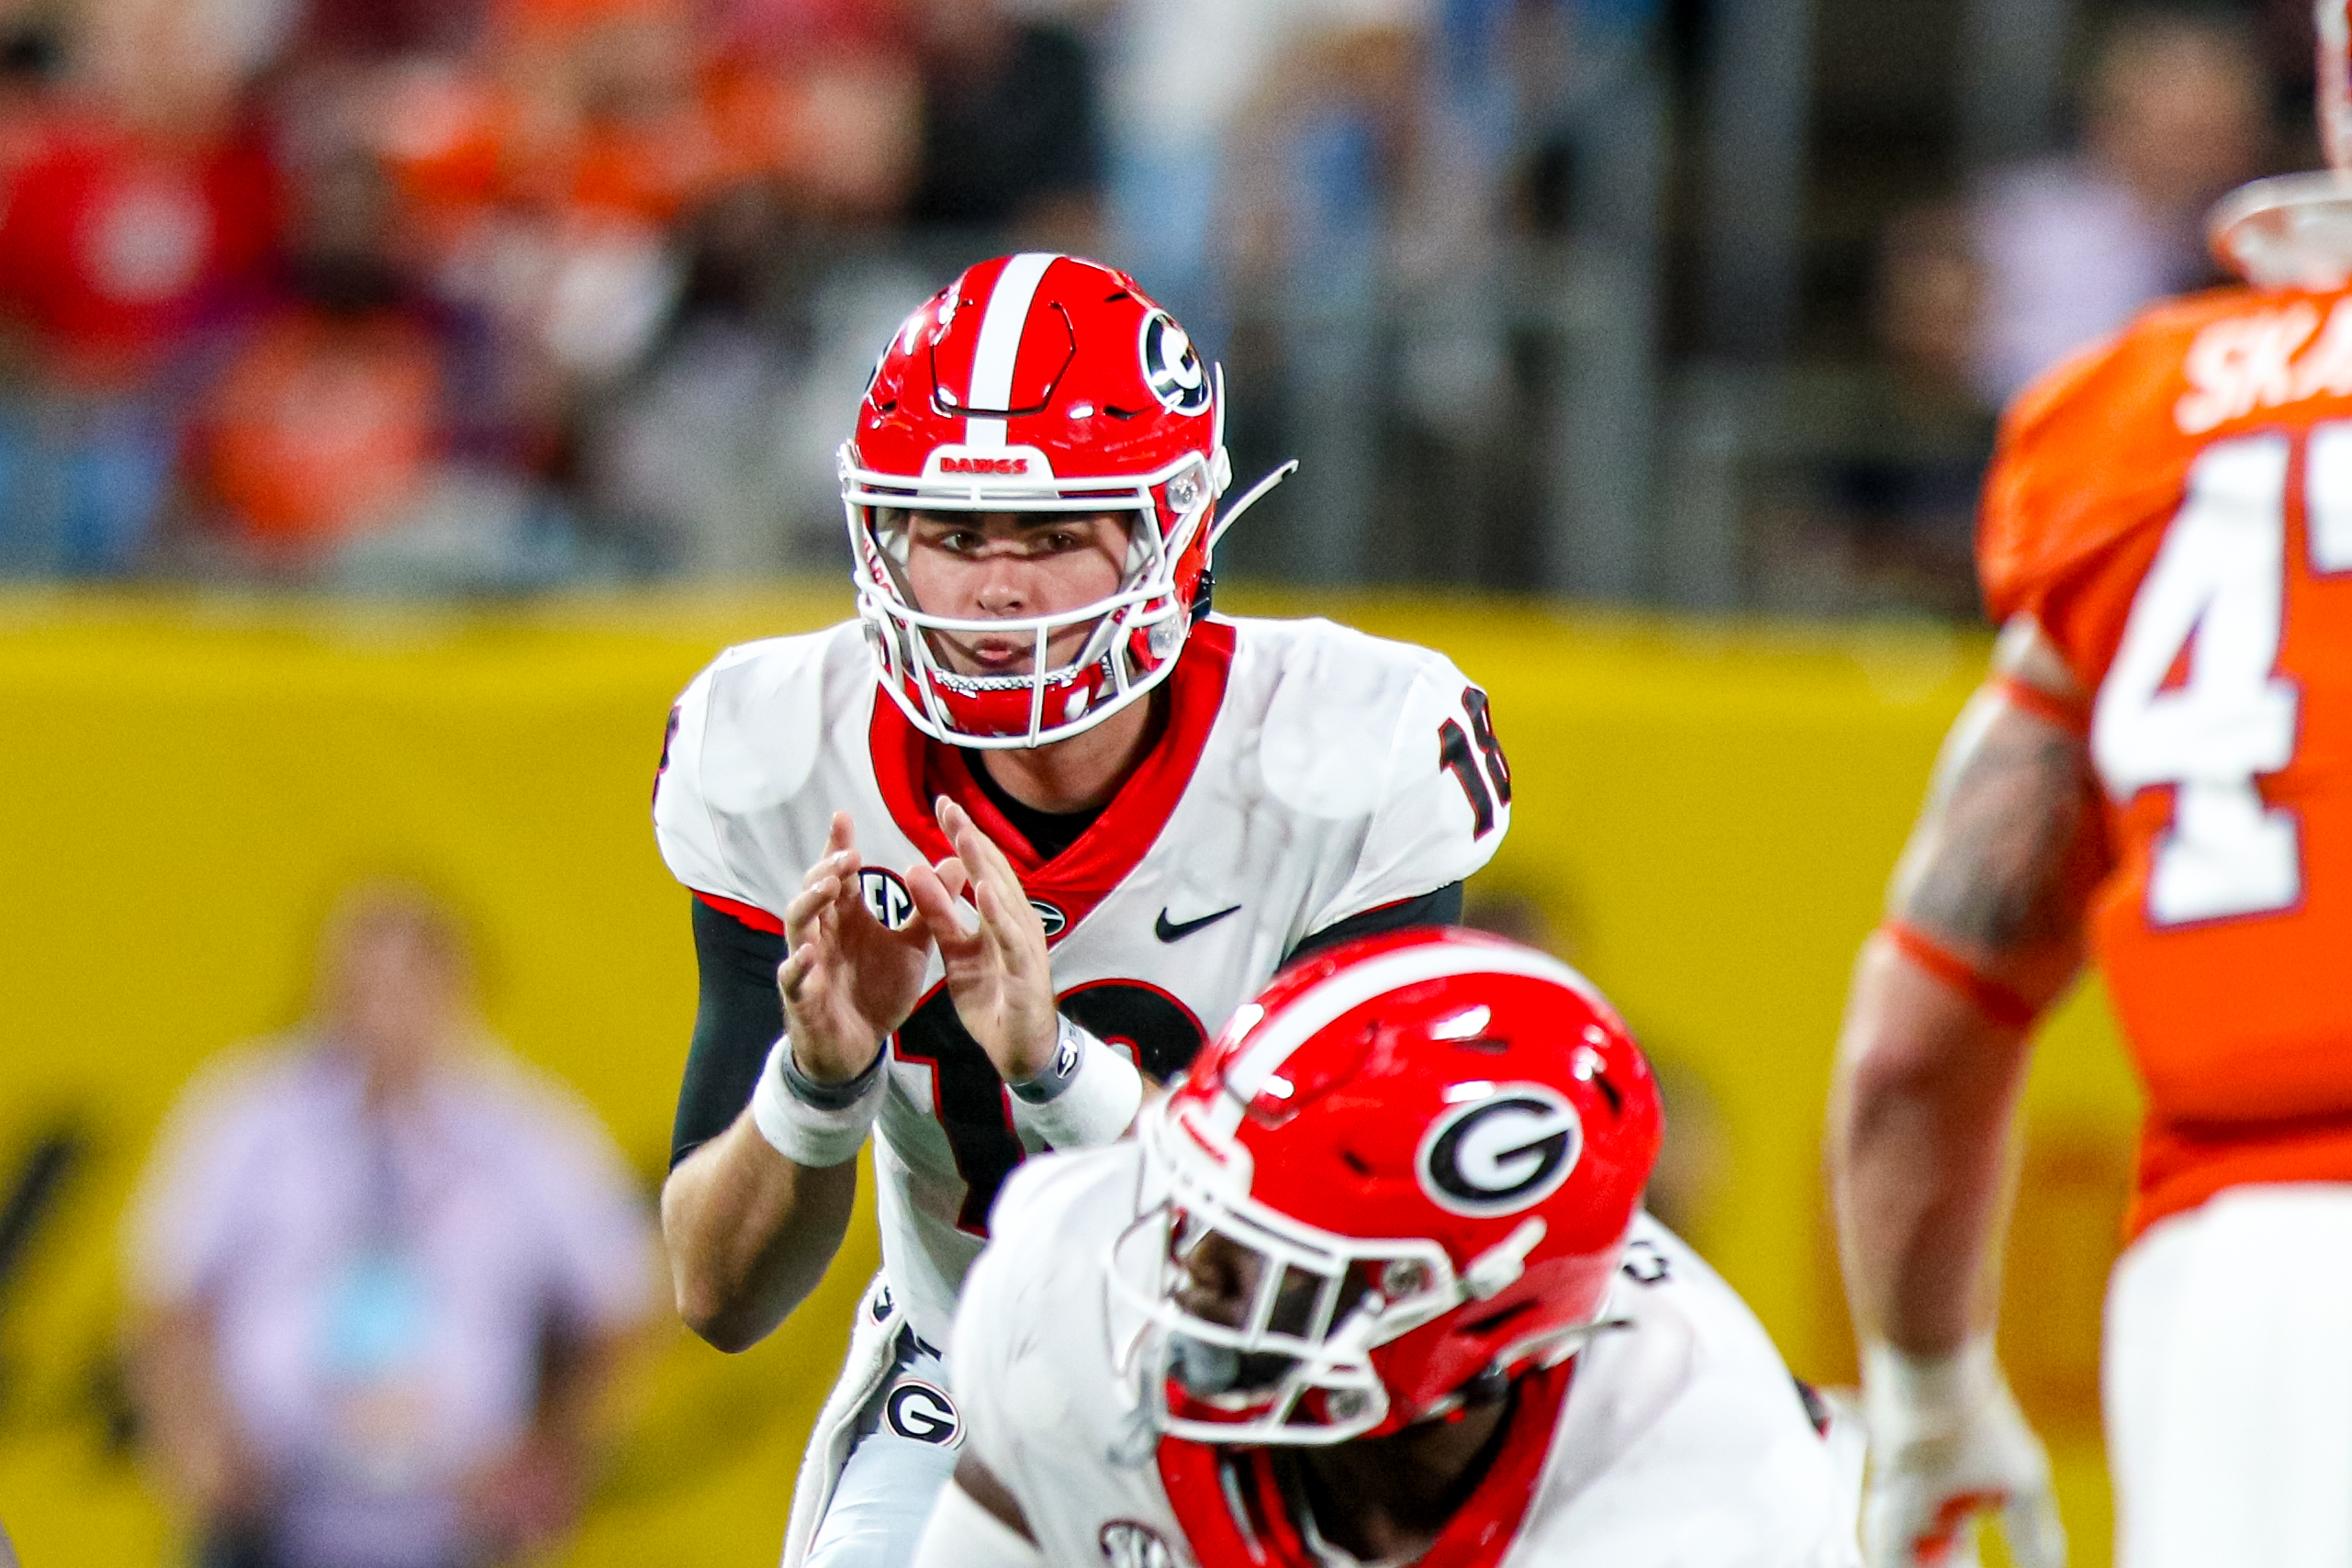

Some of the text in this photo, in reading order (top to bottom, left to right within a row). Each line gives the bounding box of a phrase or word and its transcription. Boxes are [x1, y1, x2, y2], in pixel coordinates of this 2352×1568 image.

[940, 456, 1029, 475] DAWGS
[1428, 1097, 1572, 1204] G
[888, 1384, 958, 1444] G
